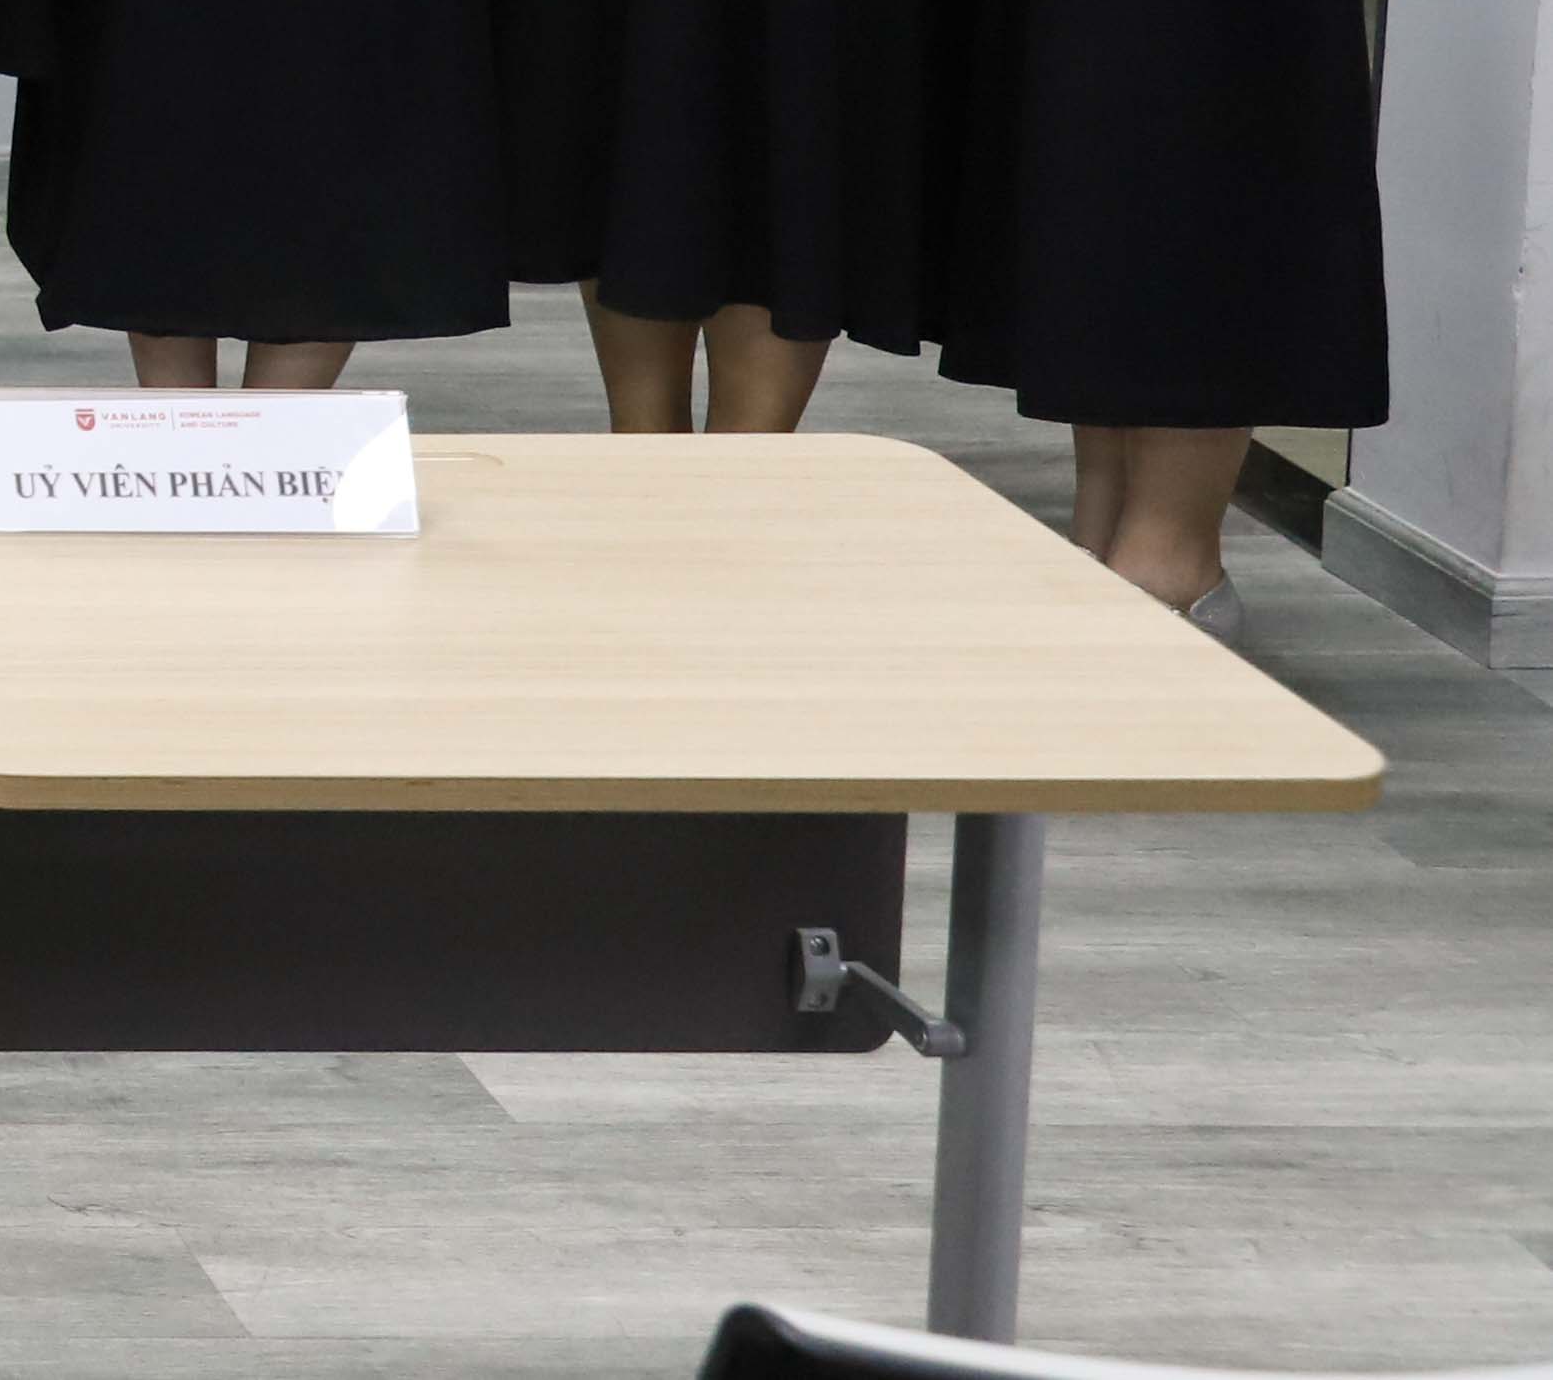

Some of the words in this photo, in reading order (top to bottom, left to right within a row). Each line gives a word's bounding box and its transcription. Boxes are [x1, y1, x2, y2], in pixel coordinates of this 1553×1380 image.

[101, 411, 167, 421] VANLANG
[14, 464, 61, 499] UỶ
[72, 464, 158, 499] VIÊN
[169, 464, 264, 499] PHẢN
[277, 466, 343, 504] BIỆ
